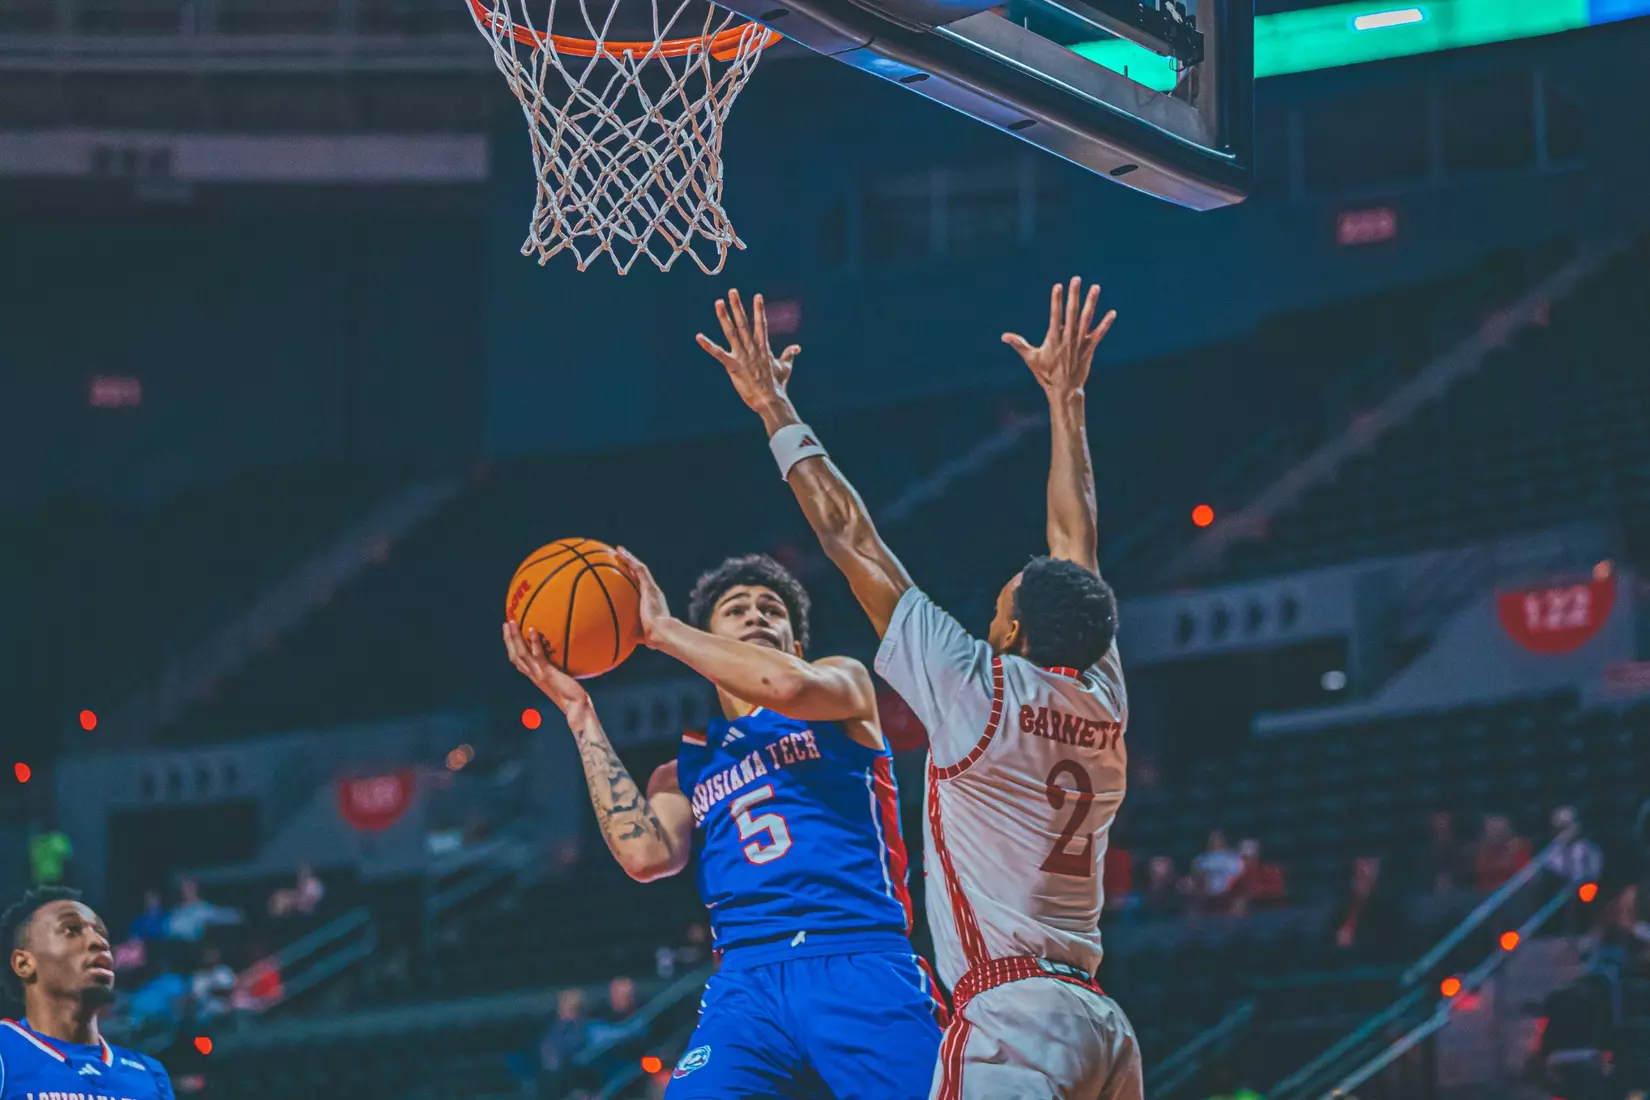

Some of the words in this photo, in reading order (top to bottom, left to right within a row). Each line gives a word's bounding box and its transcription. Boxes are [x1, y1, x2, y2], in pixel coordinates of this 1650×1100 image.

[1019, 704, 1122, 750] GARNETT
[691, 750, 768, 828] OUISIANA
[765, 729, 821, 770] TECH
[1039, 759, 1095, 877] 2
[728, 783, 793, 866] 5
